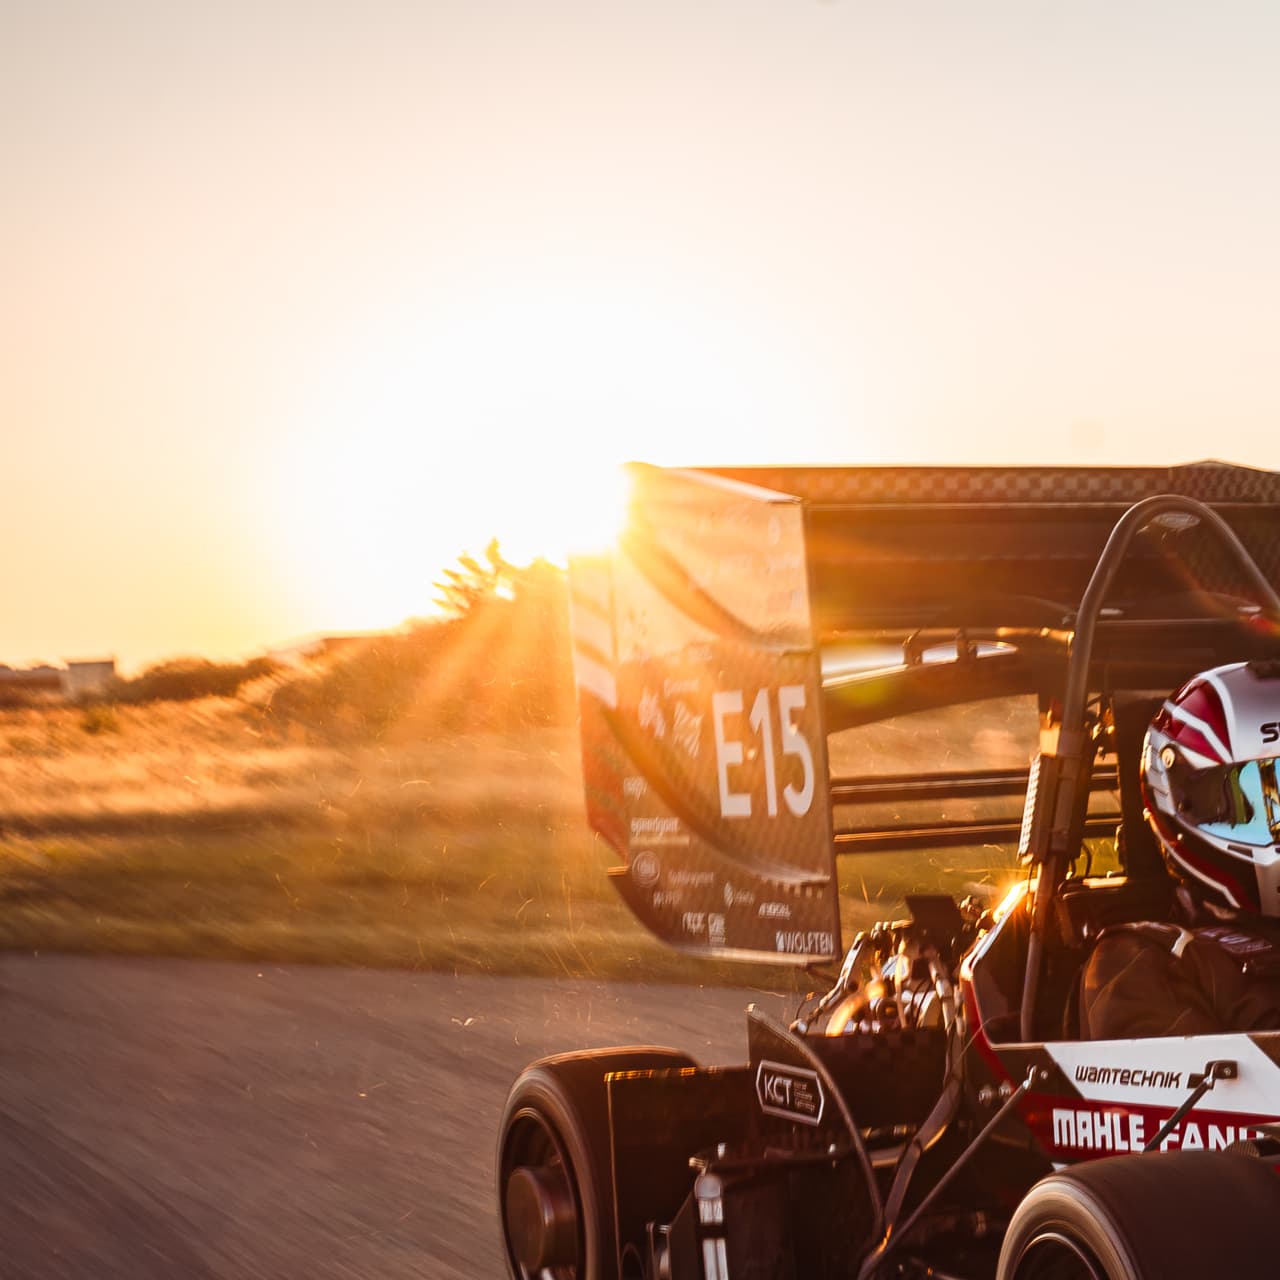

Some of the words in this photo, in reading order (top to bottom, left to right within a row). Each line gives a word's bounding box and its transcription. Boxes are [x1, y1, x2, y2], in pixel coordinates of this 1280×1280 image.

[713, 685, 814, 817] E15
[764, 1073, 792, 1105] KCT
[1053, 1108, 1145, 1152] MAHLE
